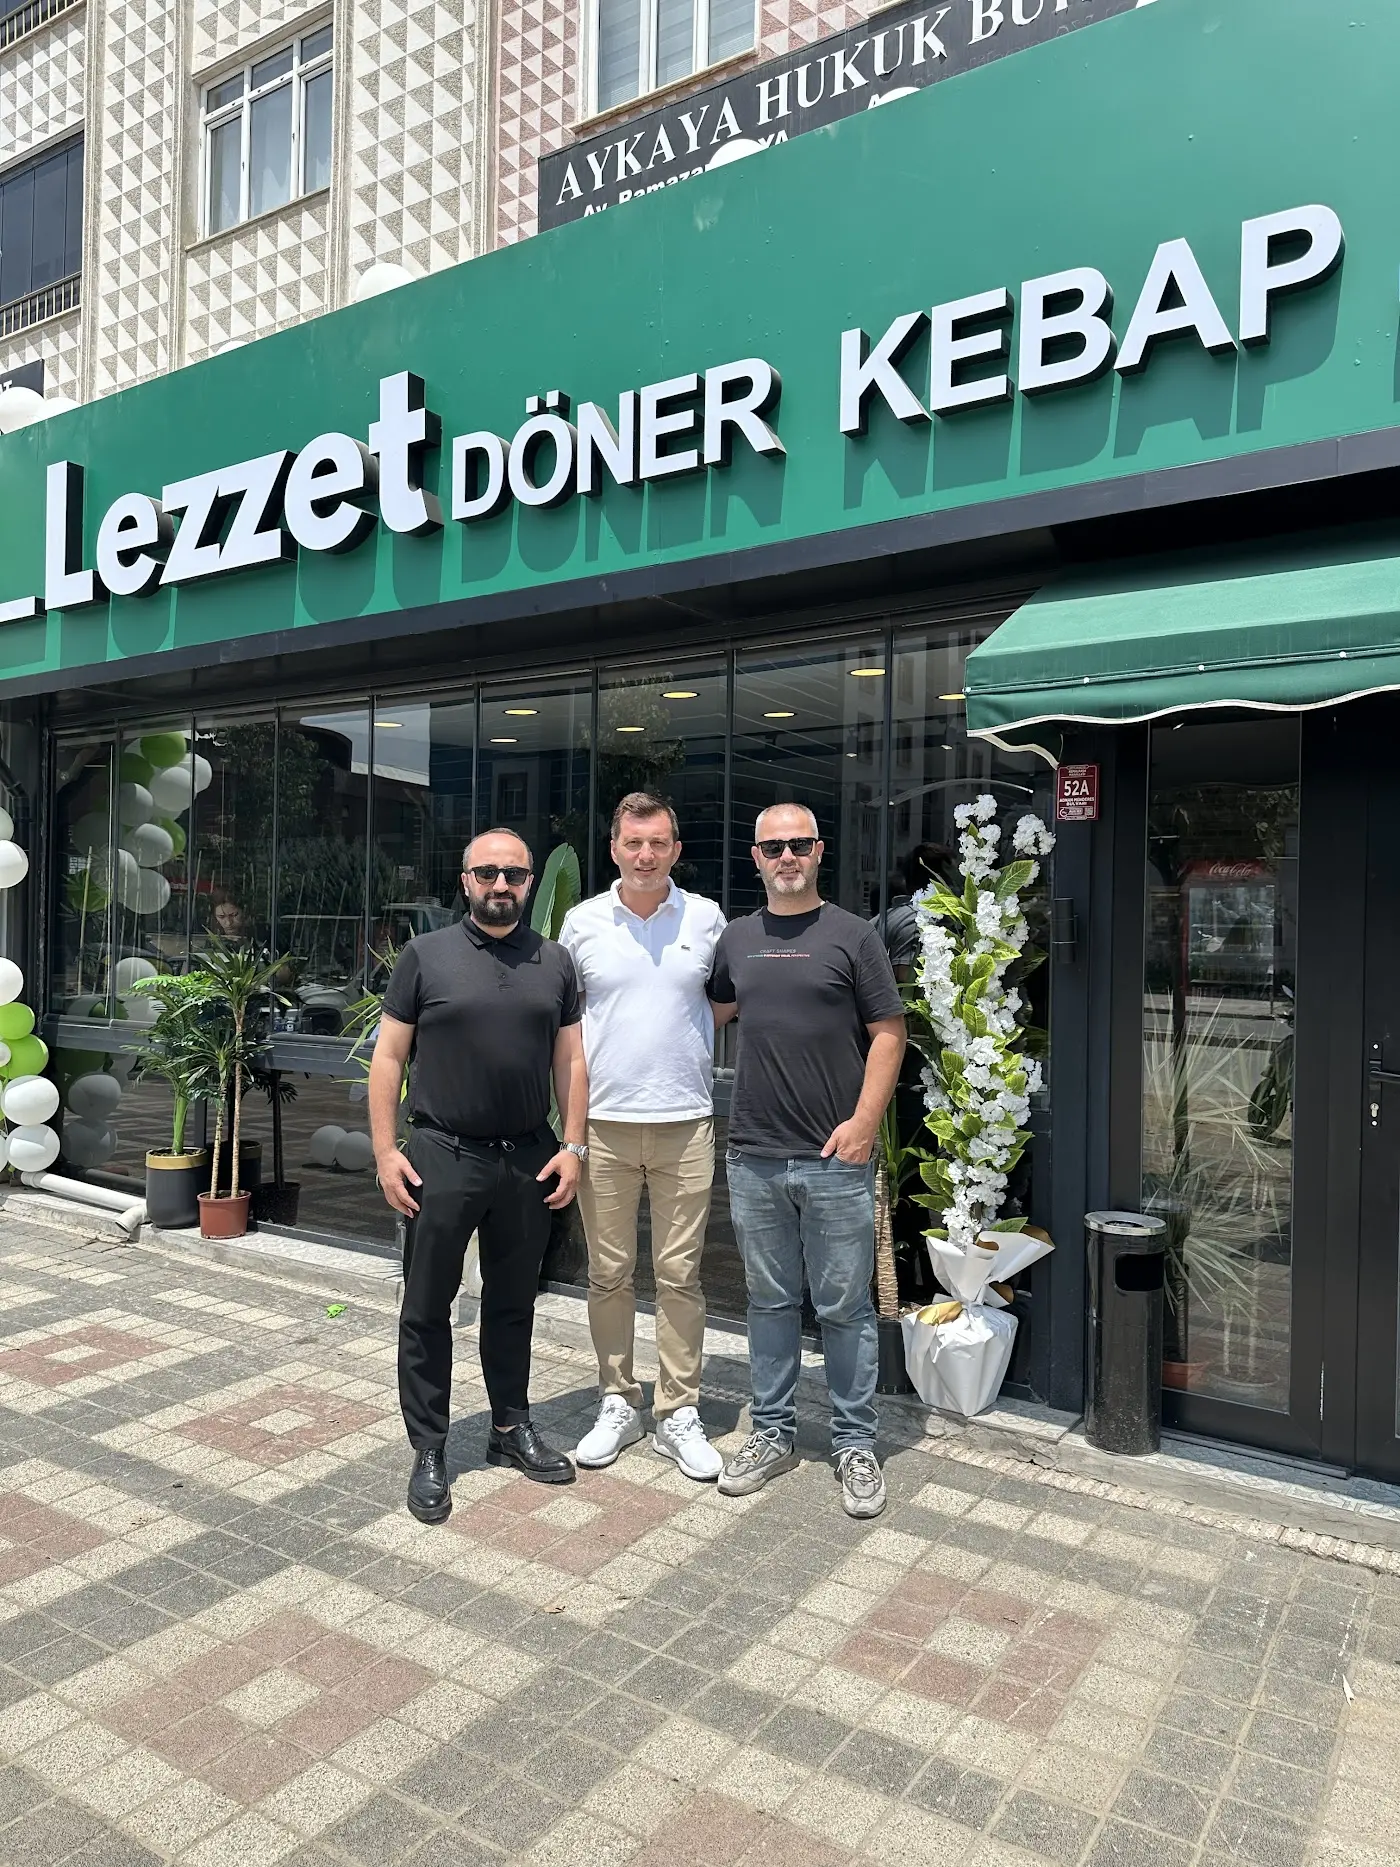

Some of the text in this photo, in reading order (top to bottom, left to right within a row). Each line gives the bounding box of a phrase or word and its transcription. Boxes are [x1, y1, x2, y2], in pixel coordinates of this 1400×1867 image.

[556, 97, 742, 205] AYKAYA
[757, 7, 951, 125] HUKUK
[45, 204, 1342, 610] Lezzet DÖNER KEBAP
[1064, 780, 1090, 797] 52A
